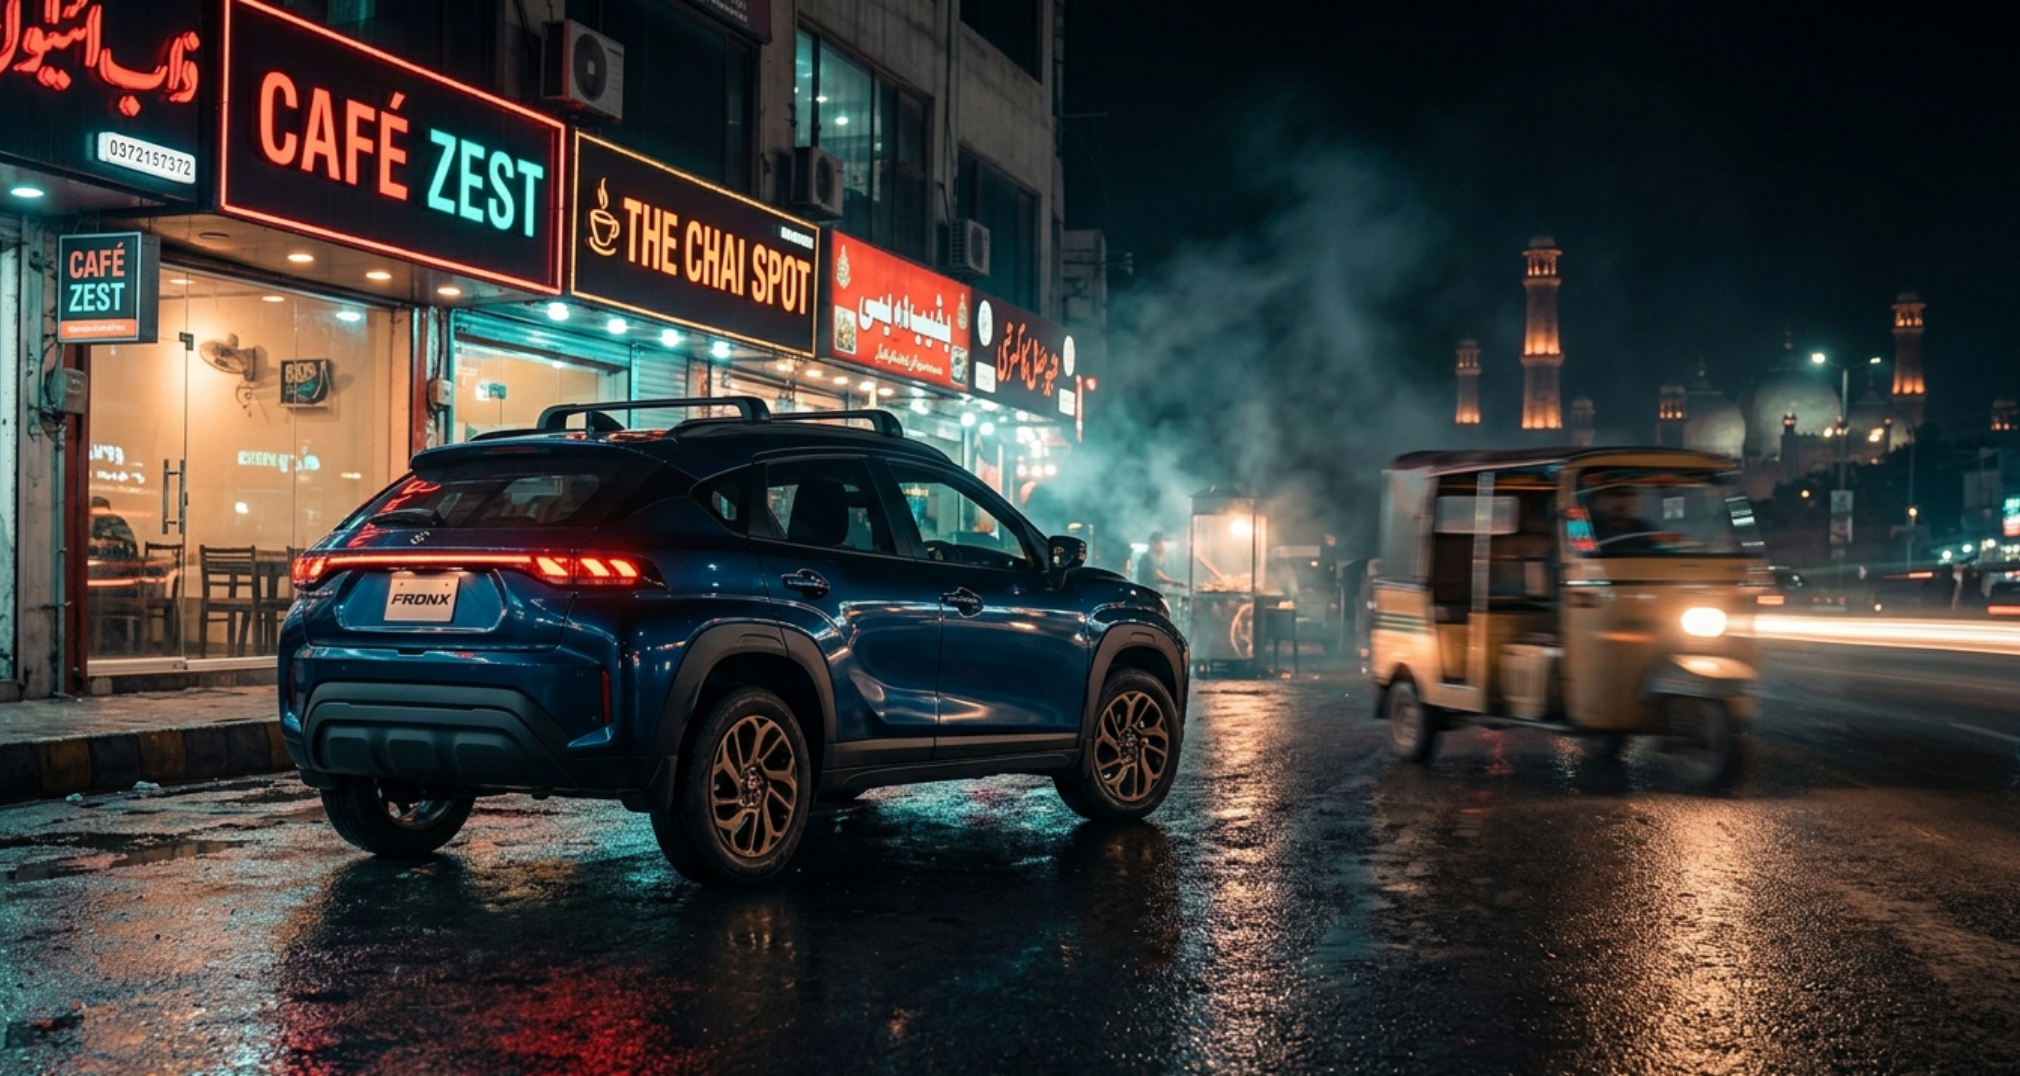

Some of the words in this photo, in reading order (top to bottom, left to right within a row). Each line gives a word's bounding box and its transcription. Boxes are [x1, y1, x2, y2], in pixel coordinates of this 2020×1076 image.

[260, 71, 408, 200] CAFÉ
[427, 128, 544, 237] ZEST
[69, 242, 125, 279] CAFÉ
[624, 197, 678, 276] THE
[685, 220, 745, 296] CHAI
[751, 243, 811, 315] SPOT
[69, 282, 125, 312] ZEST
[391, 593, 451, 606] FRONX
